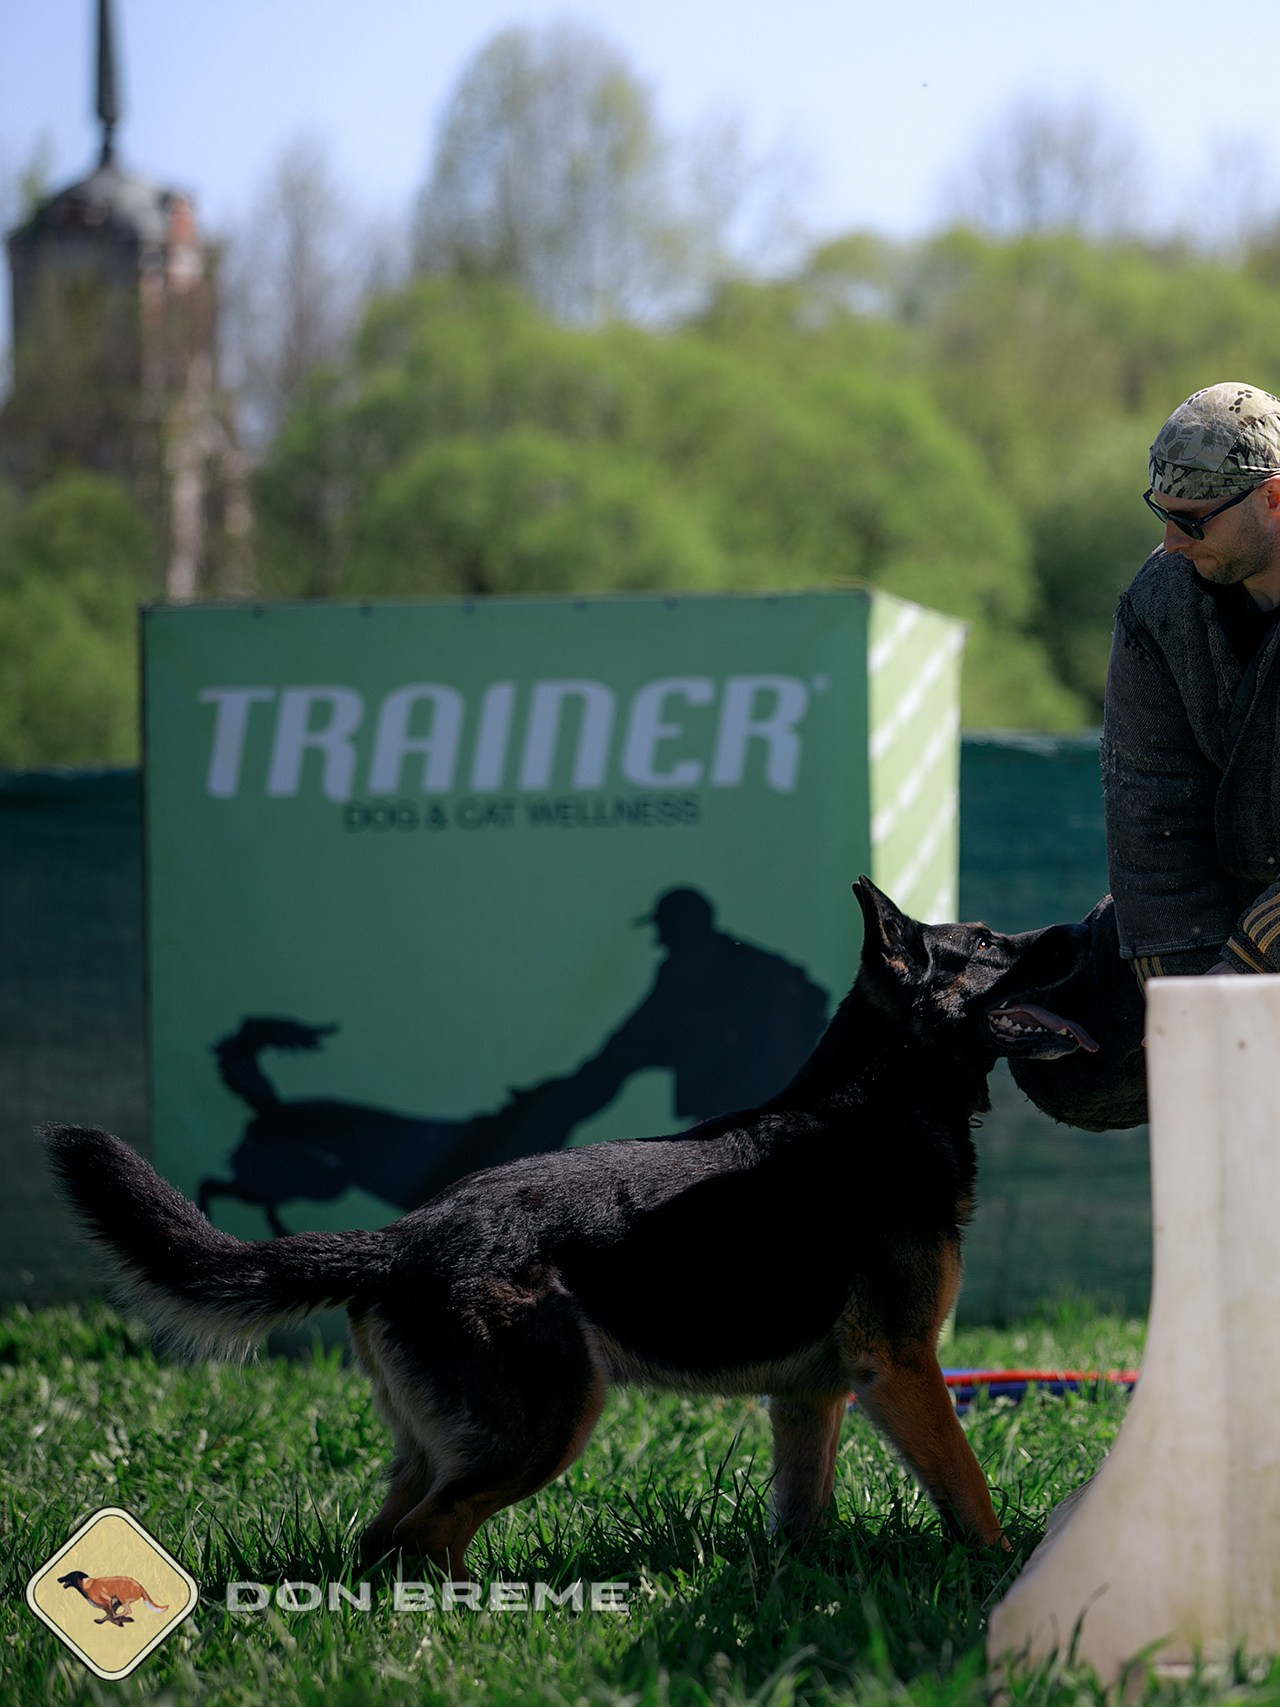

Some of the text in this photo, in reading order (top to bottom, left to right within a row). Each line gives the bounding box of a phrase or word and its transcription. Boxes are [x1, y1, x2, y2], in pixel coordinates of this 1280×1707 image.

[200, 675, 810, 802] TRAINER
[343, 795, 701, 833] DOG & CAT WELLNESS
